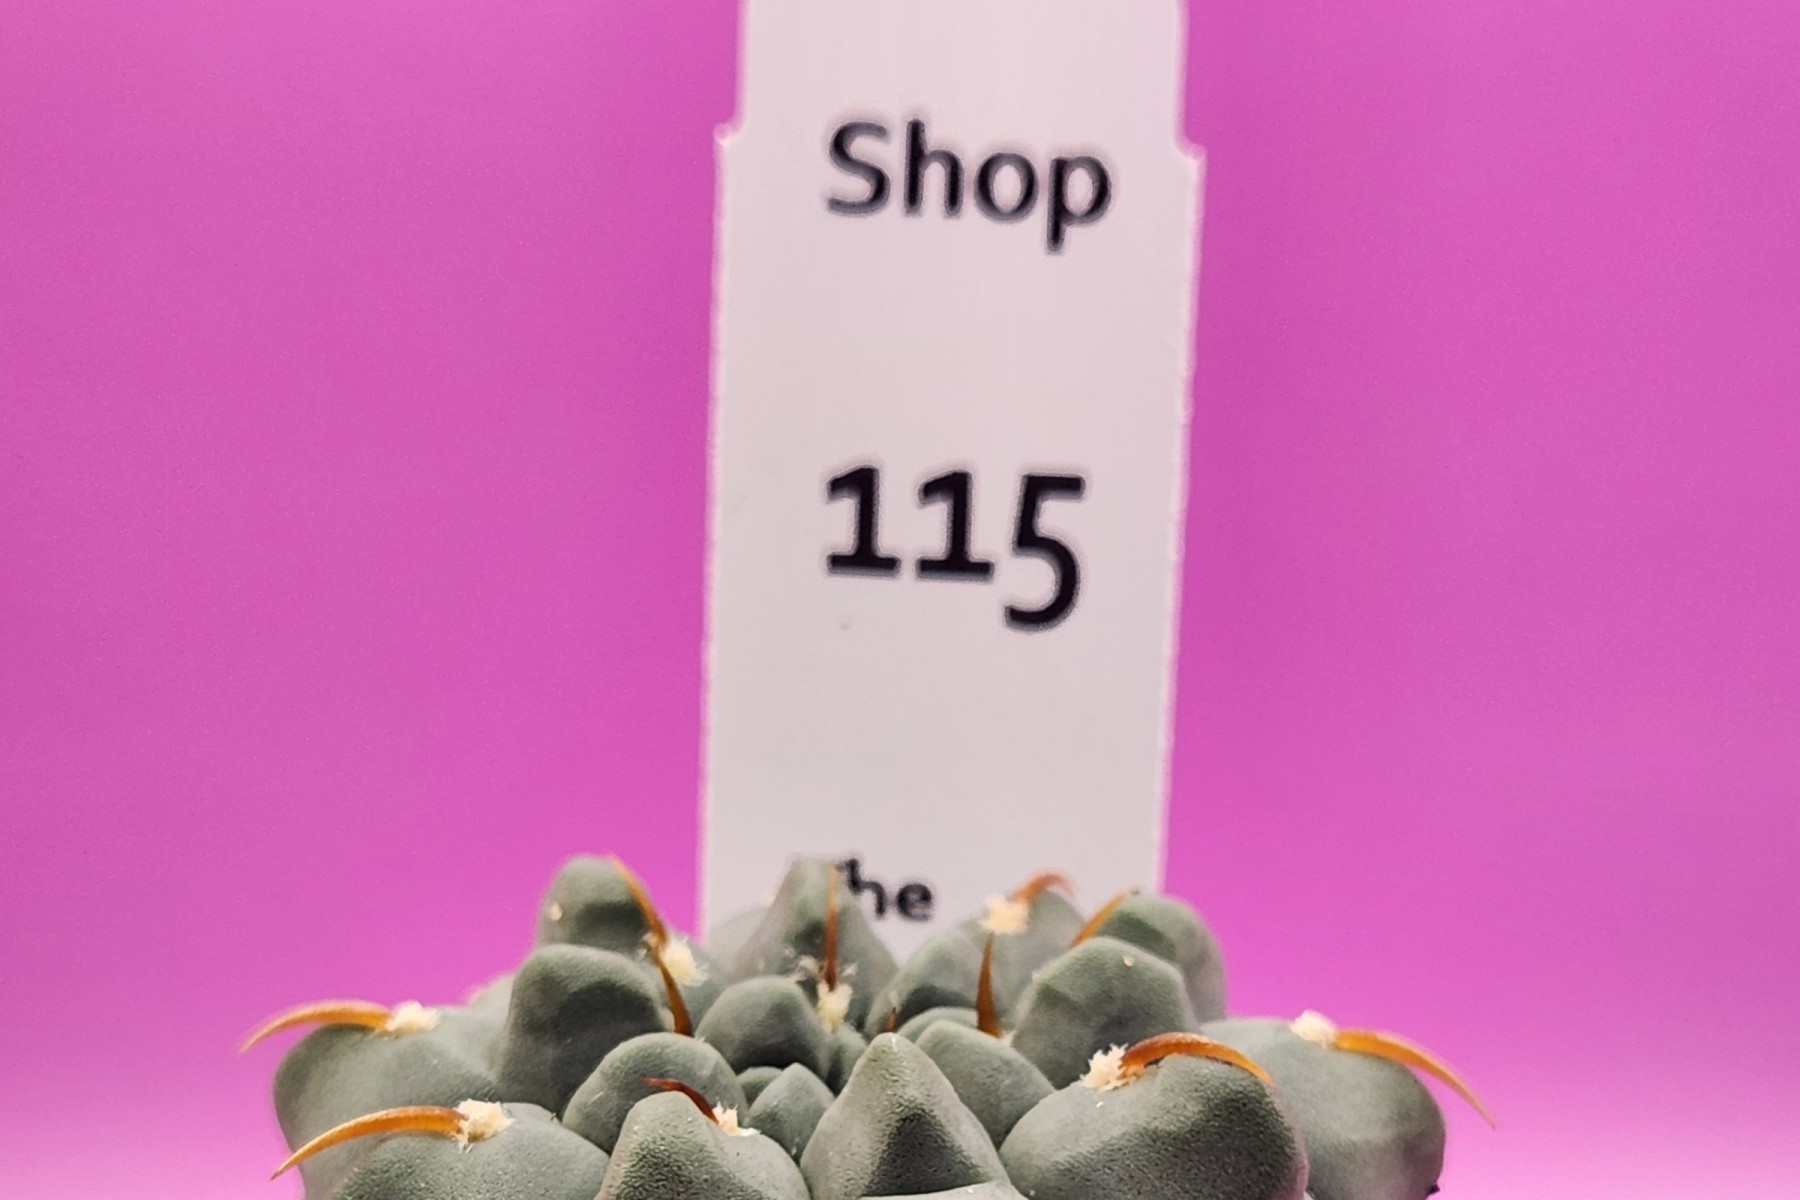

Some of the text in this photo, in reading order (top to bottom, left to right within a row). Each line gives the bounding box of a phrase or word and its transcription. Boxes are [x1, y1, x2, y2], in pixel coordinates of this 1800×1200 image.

[826, 118, 1113, 254] Shop
[825, 464, 1087, 634] 115
[835, 857, 932, 922] he
